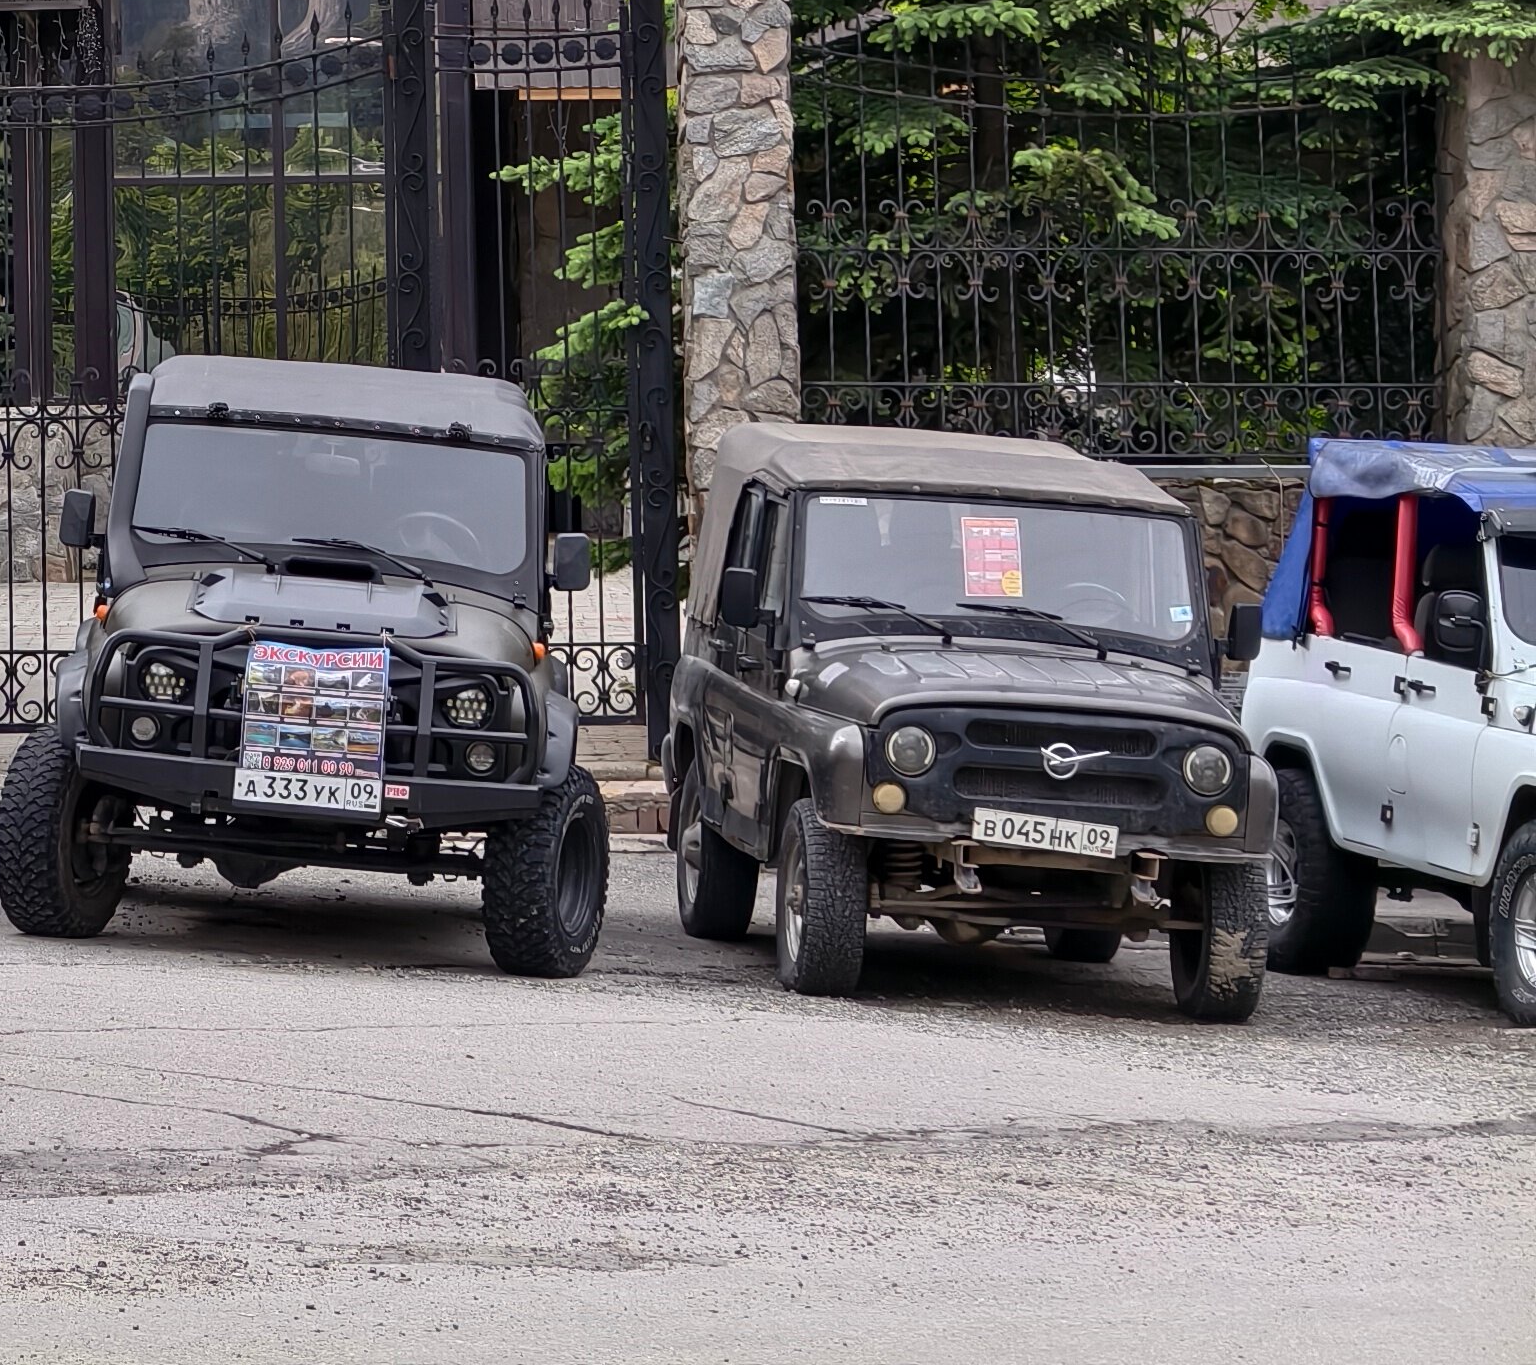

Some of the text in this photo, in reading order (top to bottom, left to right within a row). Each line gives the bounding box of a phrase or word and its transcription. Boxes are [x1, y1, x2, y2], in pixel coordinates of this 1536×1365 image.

[254, 645, 383, 668] ЭКСКУРСИИ
[262, 756, 271, 769] 8
[320, 760, 336, 774] 00
[350, 782, 374, 802] 09
[1087, 827, 1110, 847] 09
